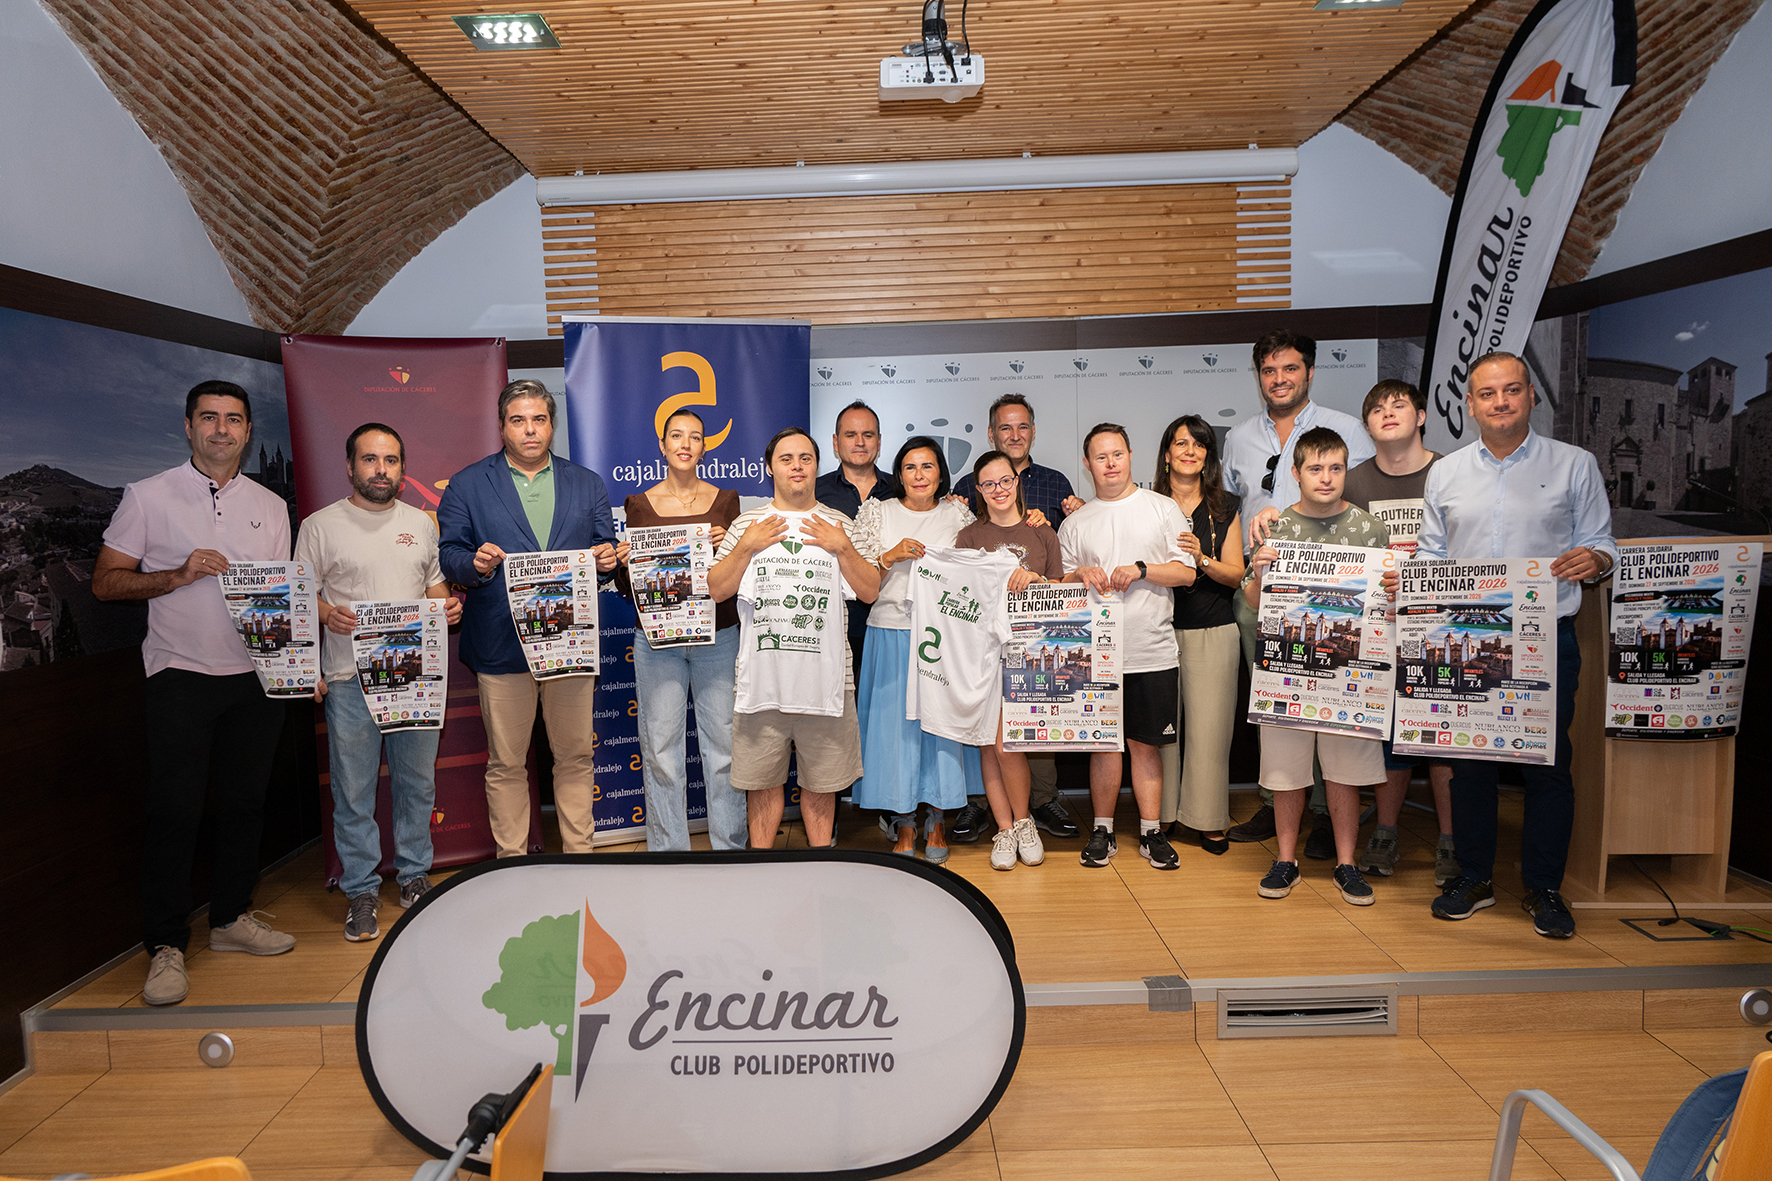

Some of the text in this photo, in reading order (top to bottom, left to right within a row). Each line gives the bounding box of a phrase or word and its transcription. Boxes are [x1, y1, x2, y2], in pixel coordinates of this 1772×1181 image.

[1435, 206, 1514, 439] Encinar
[1375, 508, 1423, 521] SOUTHER
[648, 529, 687, 540] POLIDEPORTIVO
[631, 538, 687, 550] EL ENCINAR 2026
[1277, 550, 1366, 563] LUB POLIDEPORTIVO
[1622, 547, 1645, 555] CARRERA
[509, 556, 568, 569] CLUB POLIDEPORTIVO
[803, 558, 832, 568] CÁCERES
[1621, 550, 1719, 567] CLUB POLIDEPORTIVO
[240, 567, 285, 576] POLIDEPORTIVO
[510, 564, 569, 578] EL ENCINAR 2026
[1269, 560, 1364, 575] EL ENCINAR 2026
[1402, 564, 1507, 579] CLUB POLIDEPORTIVO
[1621, 563, 1719, 581] EL ENCINAR 2026
[223, 577, 231, 585] EL
[233, 576, 266, 585] ENCINAR
[1402, 578, 1507, 592] EL ENCINAR 2026
[802, 585, 830, 595] Occident
[1007, 588, 1088, 601] CLUB POLIDEPORTIVO
[938, 591, 950, 605] I
[356, 609, 373, 617] CLUB
[376, 605, 419, 615] POLIDEPORTIVO
[1007, 599, 1088, 613] EL ENCINAR 2026
[940, 605, 980, 623] EL ENCINAR
[368, 615, 401, 625] ENCINAR
[600, 627, 636, 638] cajalmend
[1264, 640, 1281, 652] 10K
[1293, 644, 1305, 654] 5K
[1620, 652, 1638, 663] 10K
[1653, 652, 1665, 663] 5K
[1345, 670, 1373, 680] DOWN
[1406, 665, 1424, 676] 10K
[1438, 667, 1451, 678] 5K
[1709, 671, 1733, 680] DOWN
[1010, 674, 1025, 683] 10K
[1036, 675, 1046, 683] 5K
[1262, 691, 1292, 700] Occident
[1499, 691, 1530, 701] DOWN
[1408, 720, 1440, 728] Occident
[1524, 726, 1547, 735] BERS
[606, 786, 644, 799] cajalmend
[594, 816, 624, 826] ndralejo
[627, 969, 900, 1051] Encinar
[670, 1052, 895, 1077] CLUB POLIDEPORTIVO
